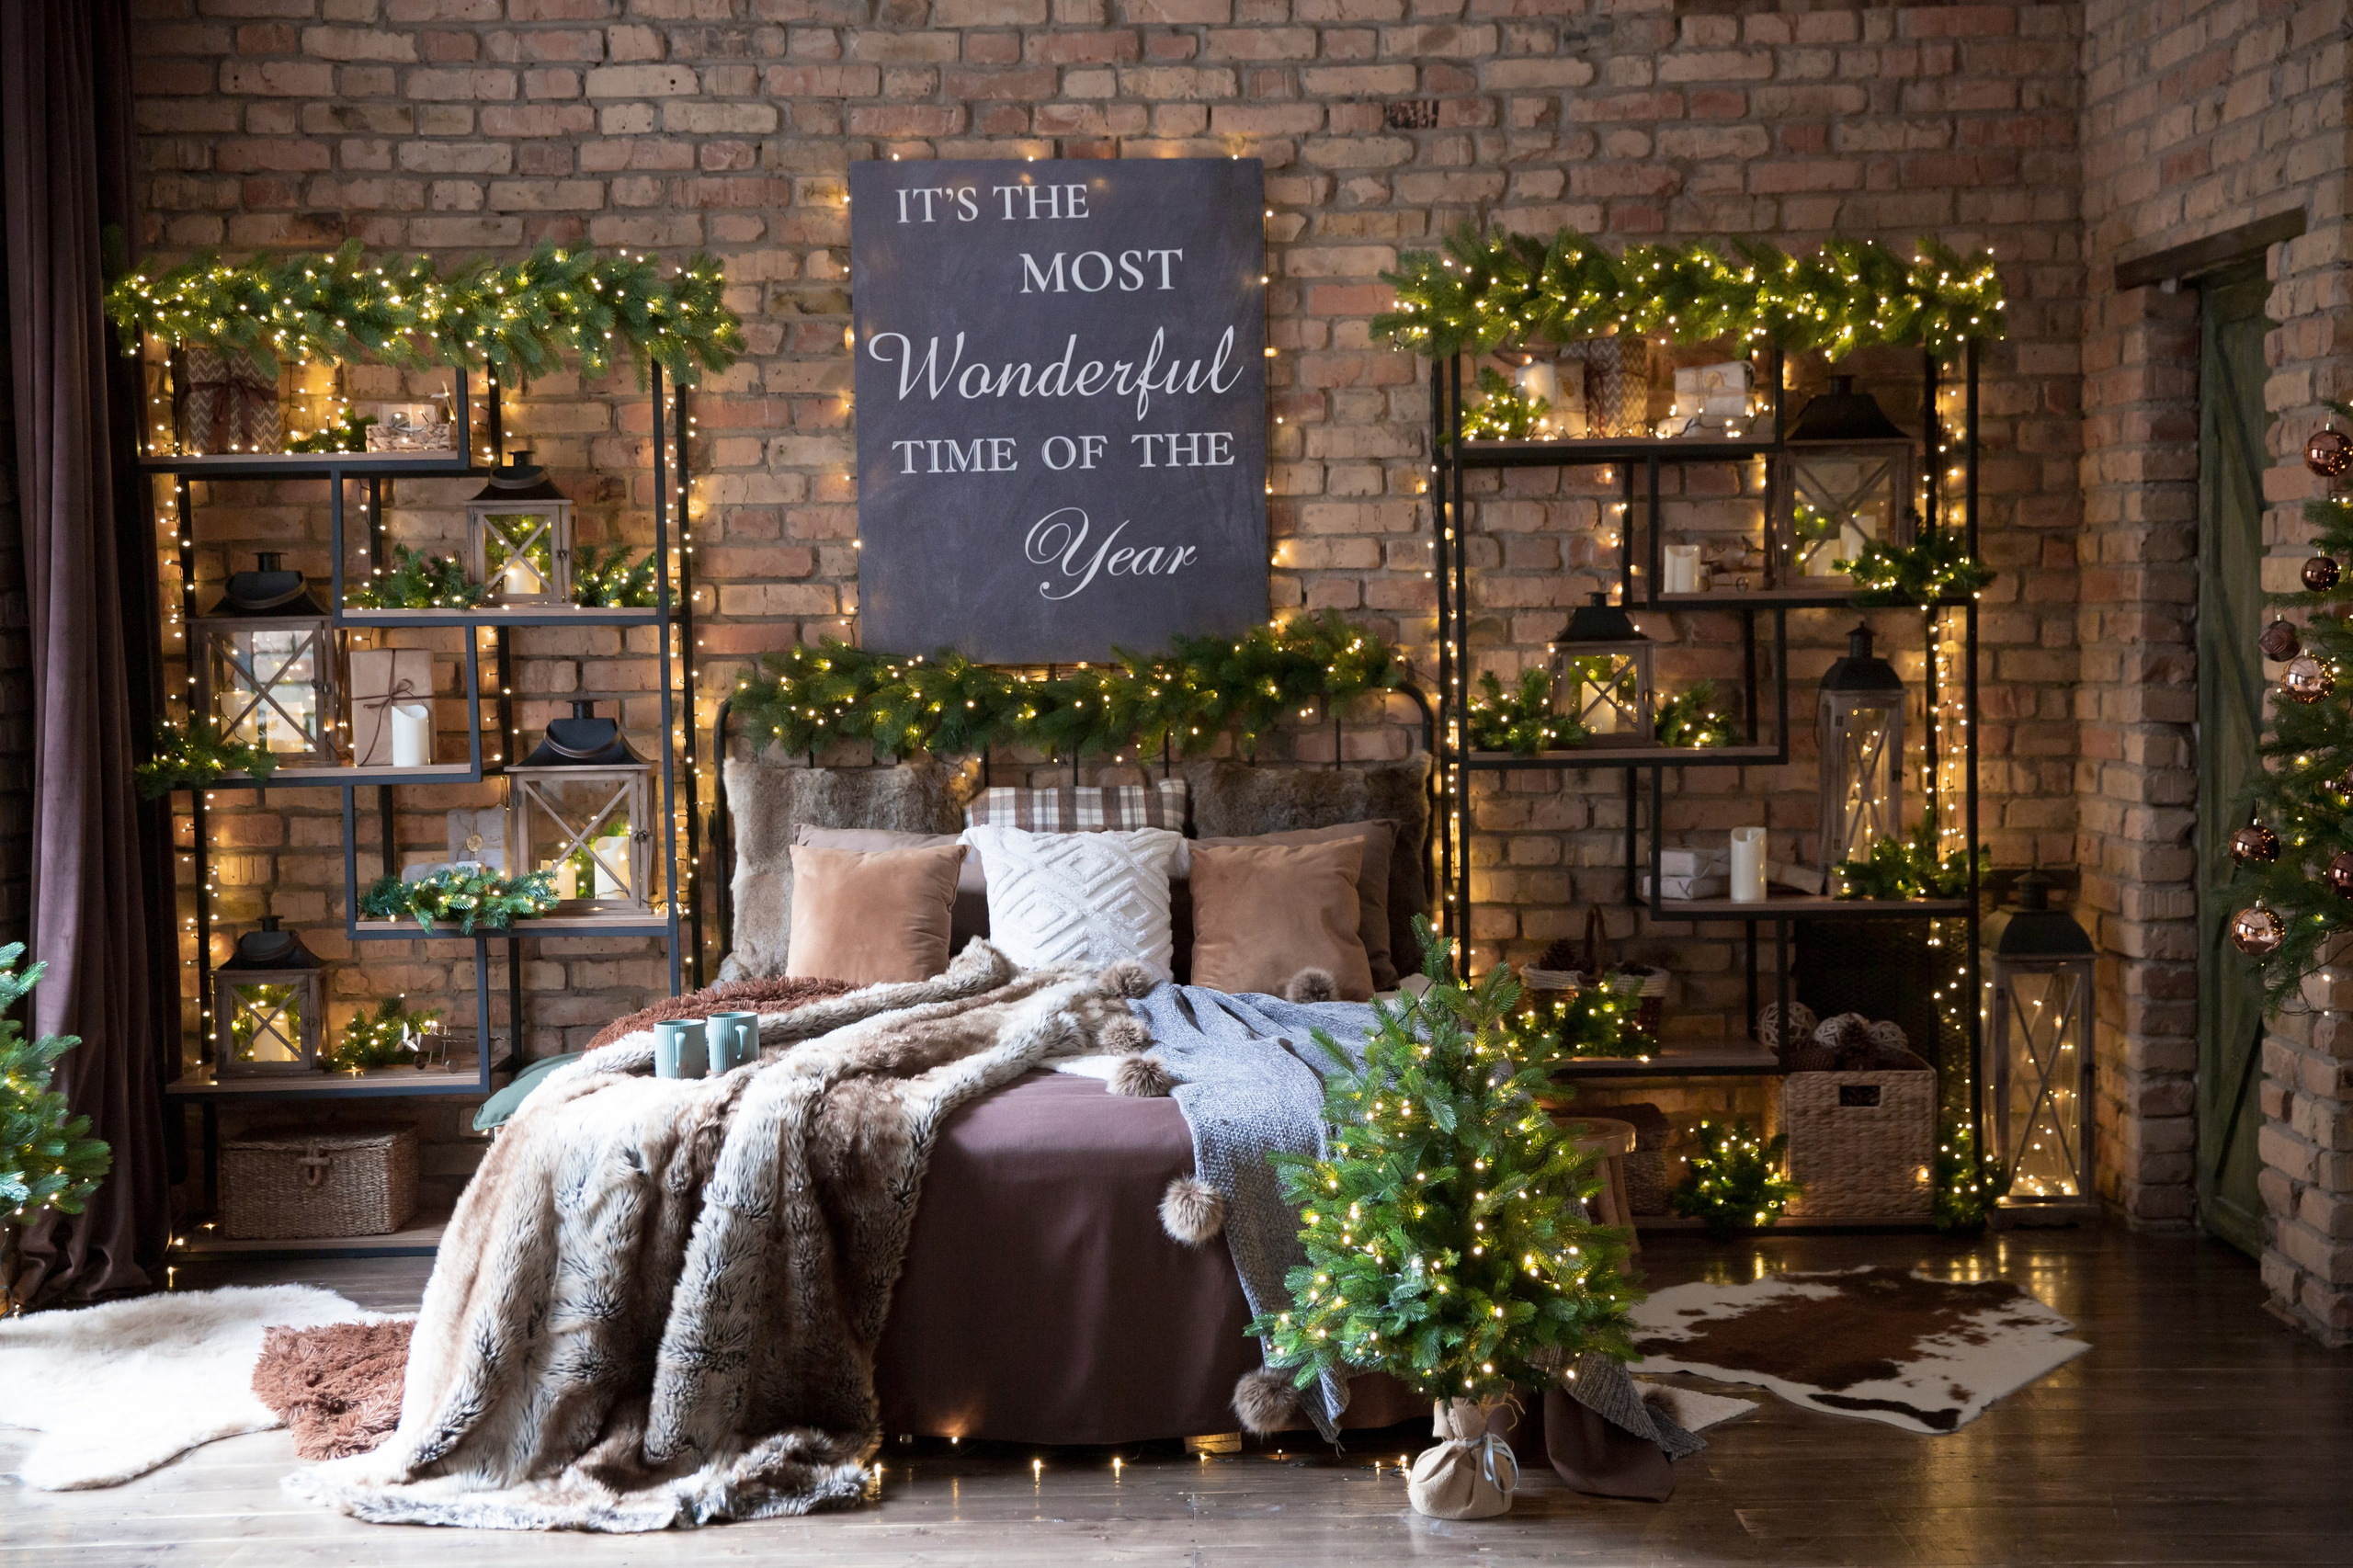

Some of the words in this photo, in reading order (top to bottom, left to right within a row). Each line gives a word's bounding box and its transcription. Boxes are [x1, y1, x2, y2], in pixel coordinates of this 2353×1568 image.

[895, 186, 980, 224] IT'S
[993, 183, 1090, 221] THE
[1018, 247, 1184, 294] MOST
[868, 324, 1245, 422] Wonderful
[891, 437, 1019, 475] TIME
[1040, 434, 1109, 472] OF
[1130, 431, 1236, 468] THE
[1024, 506, 1198, 601] Year
